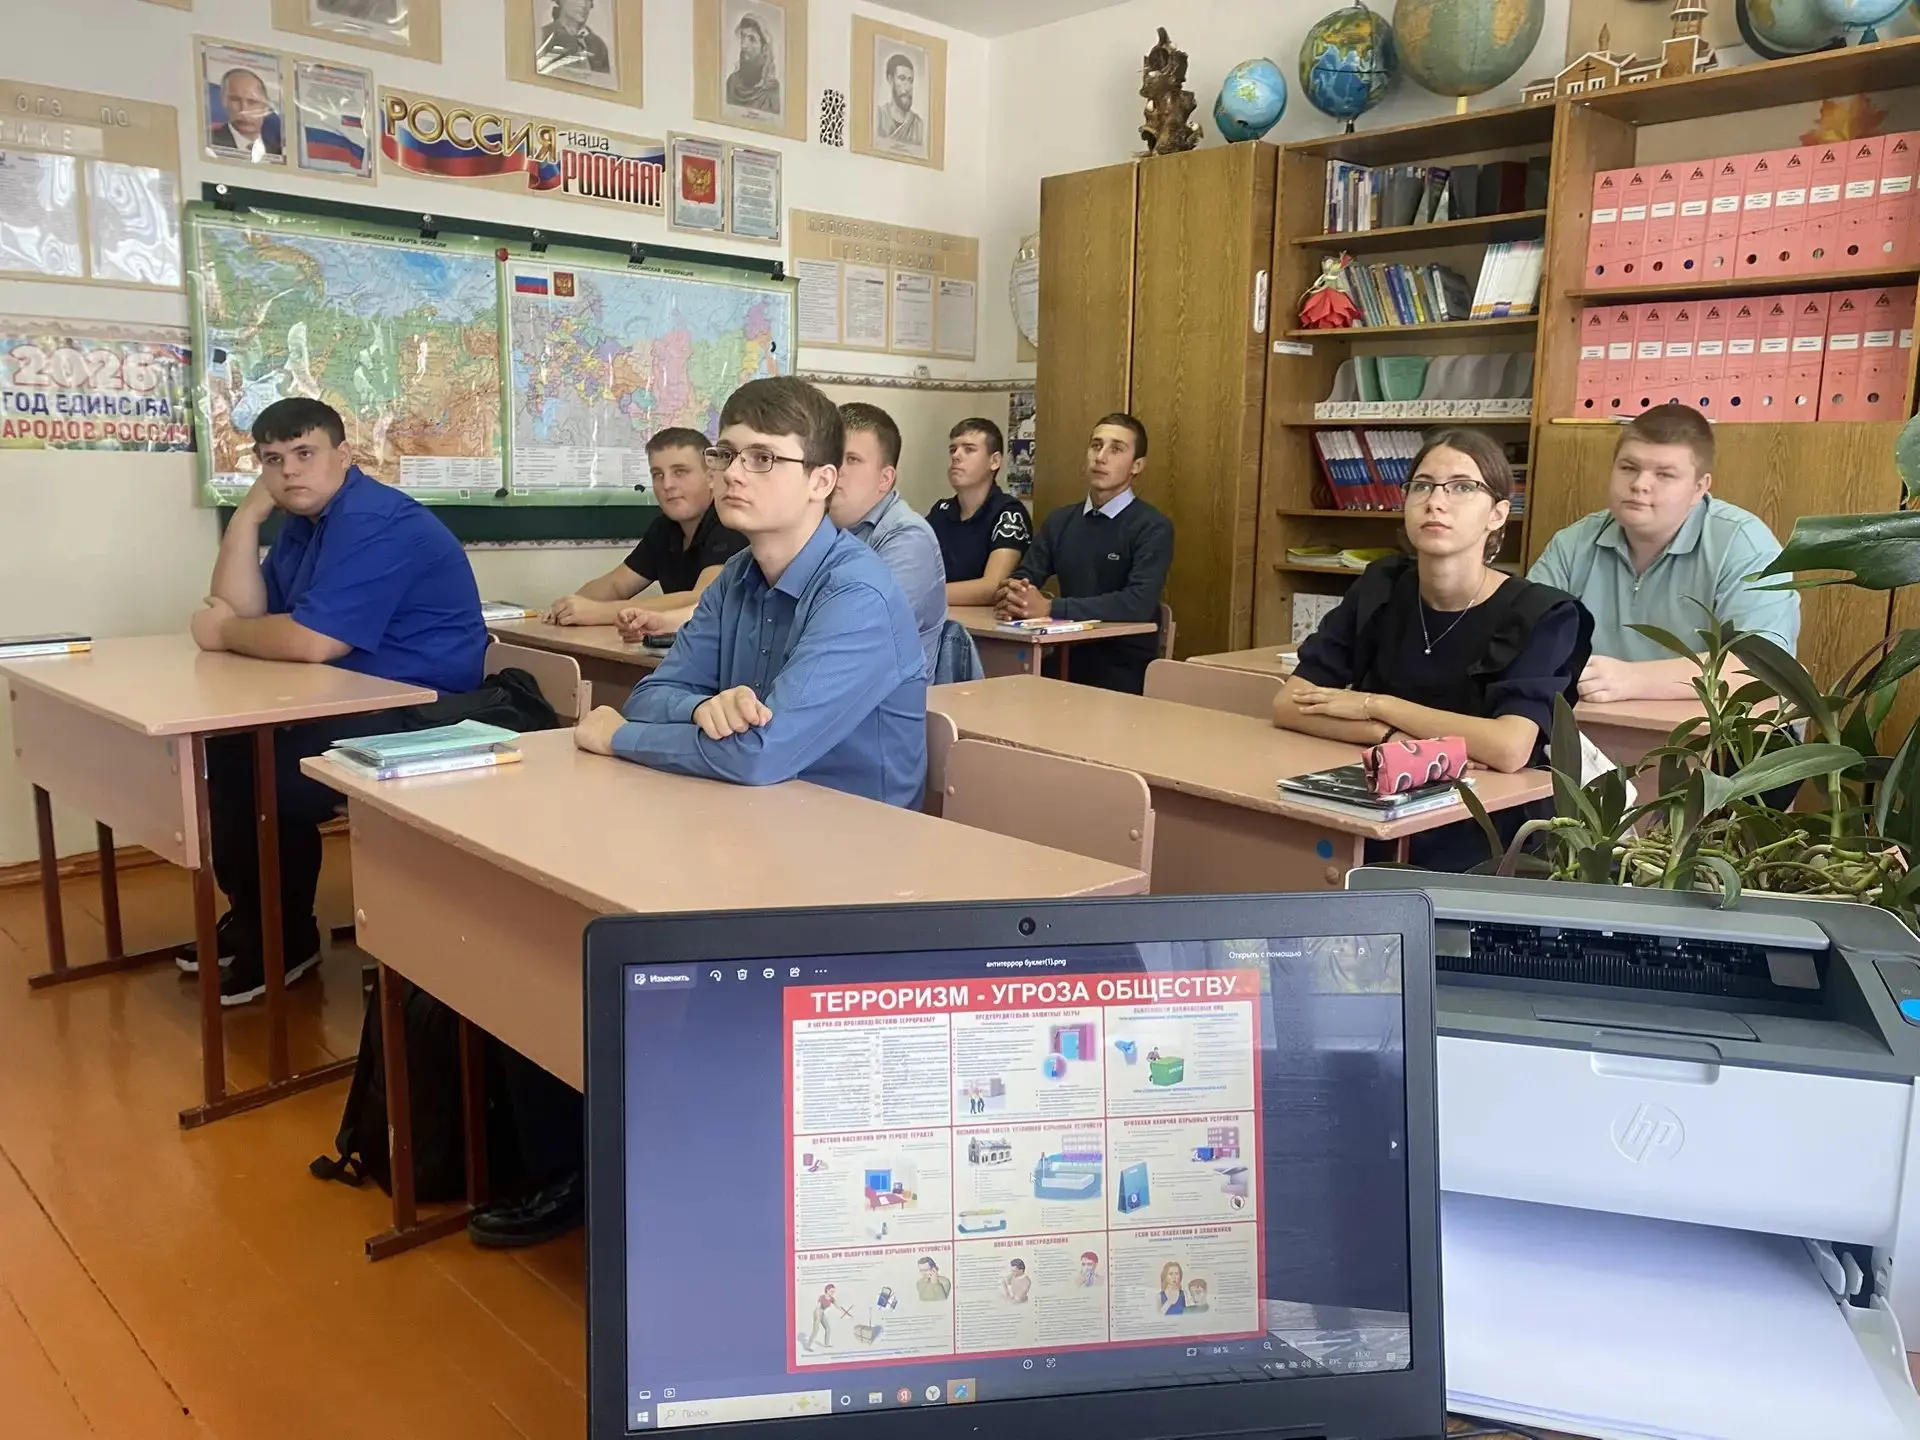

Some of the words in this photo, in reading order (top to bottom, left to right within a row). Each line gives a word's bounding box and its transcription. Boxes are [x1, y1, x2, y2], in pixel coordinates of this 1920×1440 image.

[385, 94, 557, 163] РОССИЯ
[562, 149, 661, 207] РОДИНА!
[9, 344, 158, 392] 2026
[3, 392, 50, 415] ГОД
[57, 393, 172, 417] ЕДИНСТВА
[104, 422, 191, 443] РОССИИ
[986, 959, 1023, 969] антитеррор
[1228, 951, 1259, 960] Открыть
[1266, 950, 1302, 959] помощью
[650, 974, 690, 984] Изменить
[810, 985, 969, 1013] ТЕРРОРИЗМ
[991, 980, 1090, 1005] УГРОЗА
[1096, 975, 1238, 1002] ОБЩЕСТВУ
[1620, 1102, 1677, 1165] hp
[682, 1407, 710, 1418] Поиск
